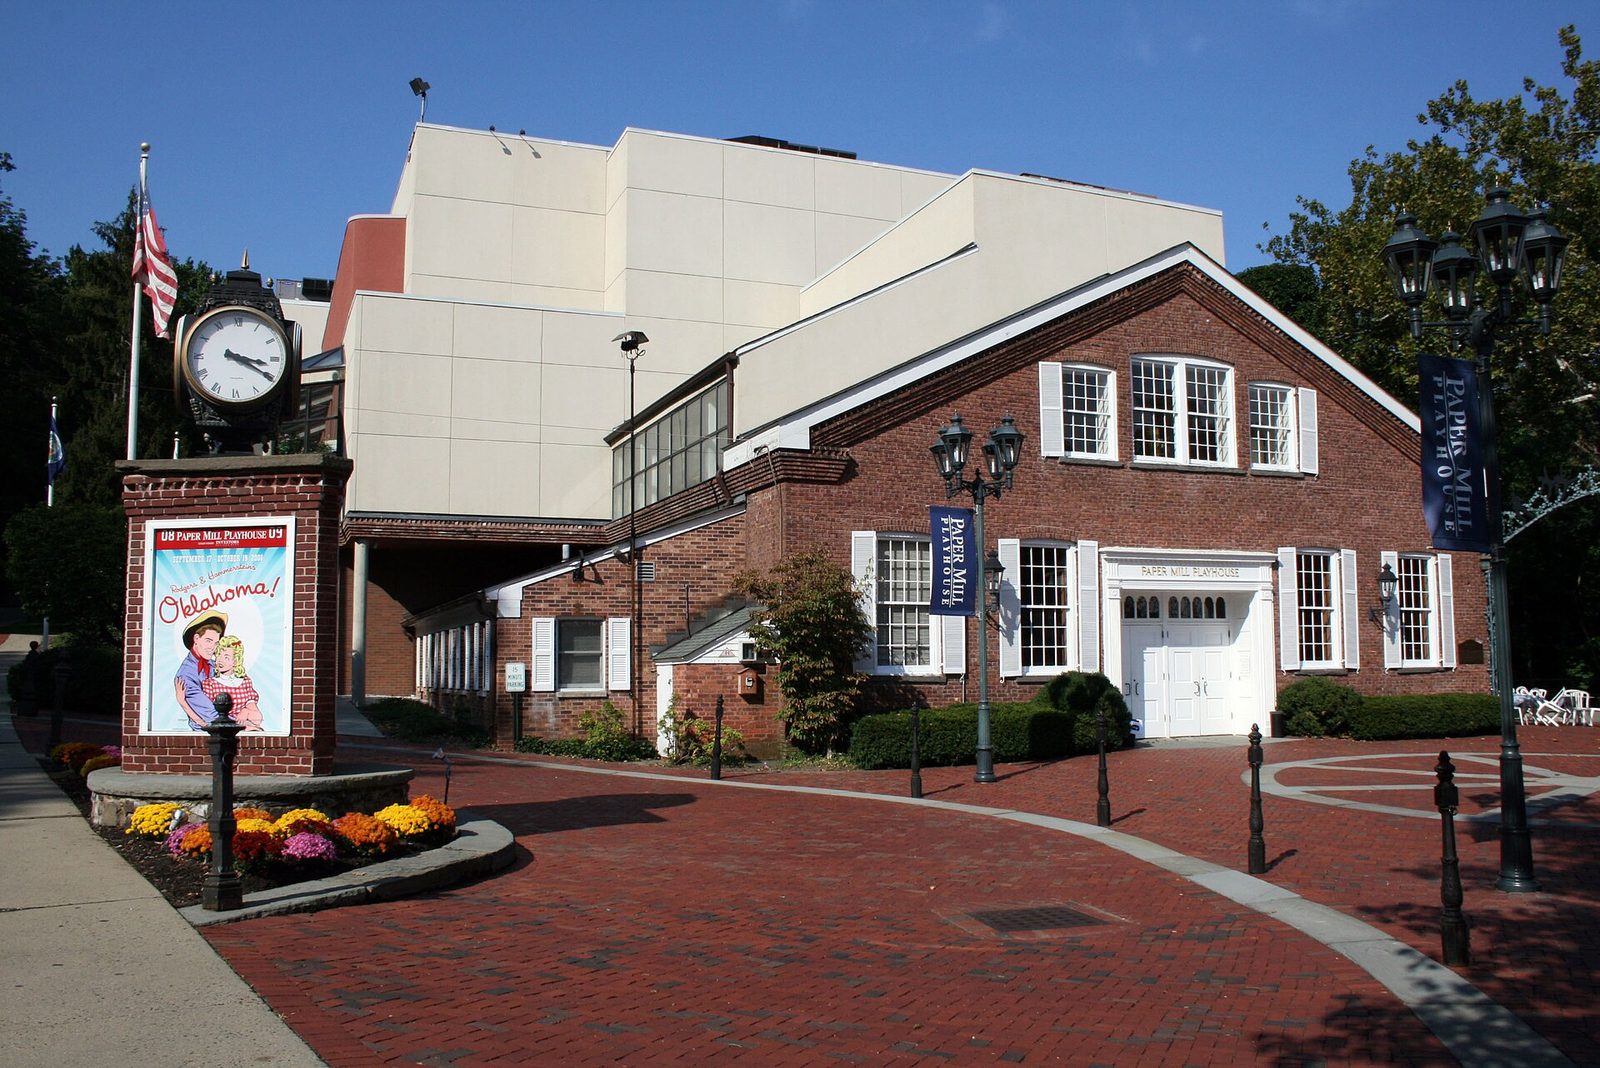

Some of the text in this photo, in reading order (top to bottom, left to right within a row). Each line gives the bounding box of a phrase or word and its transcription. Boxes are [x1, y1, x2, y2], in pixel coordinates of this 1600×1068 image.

[1432, 375, 1456, 533] PLAYHOUSE
[1445, 376, 1473, 533] PAPER MILL
[176, 532, 201, 541] PAPER
[203, 531, 223, 540] MILL
[223, 530, 267, 540] PLAYHOUSE
[172, 555, 205, 563] SEPTEMBER
[940, 517, 951, 605] PLAYHOUSE
[950, 517, 967, 606] PAPER MILL
[1141, 566, 1240, 578] PAPER MILL PLAYHOUSE
[159, 577, 280, 623] Oklahoma!
[170, 582, 198, 594] Rodgers
[199, 576, 206, 585] &
